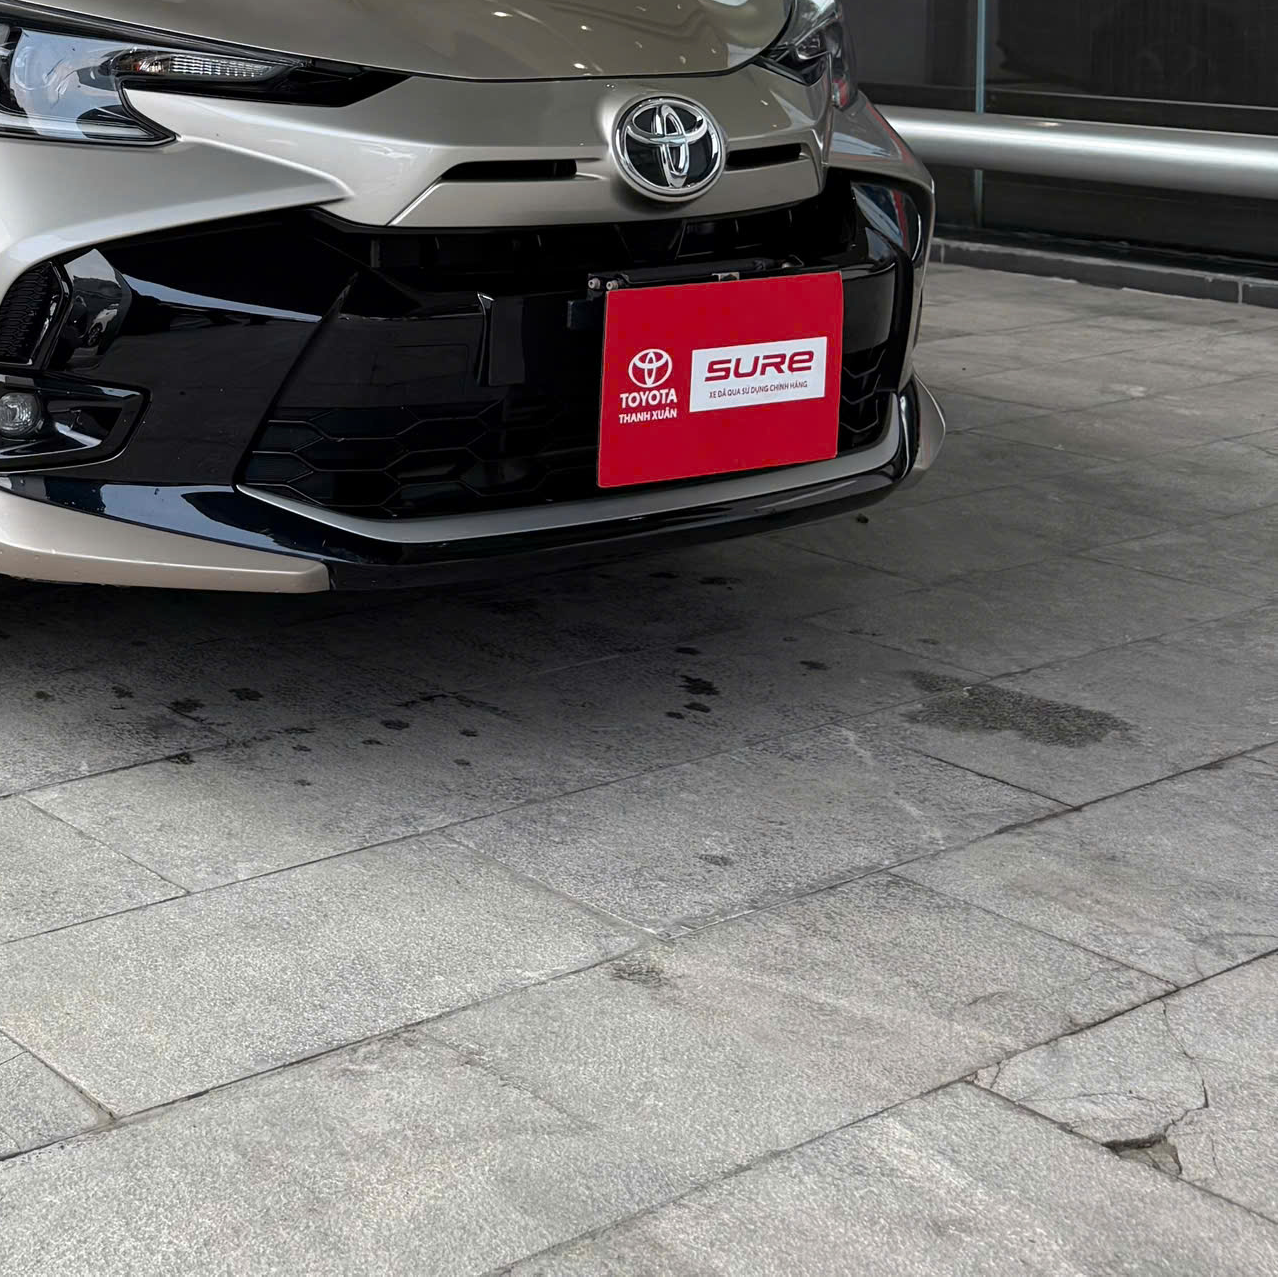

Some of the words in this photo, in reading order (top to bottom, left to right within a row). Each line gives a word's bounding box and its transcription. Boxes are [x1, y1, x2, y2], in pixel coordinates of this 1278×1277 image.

[620, 388, 677, 409] TOYOTA
[709, 390, 717, 399] XE
[727, 387, 740, 397] QUA
[619, 410, 651, 424] THANH
[652, 408, 677, 421] XUÂN
